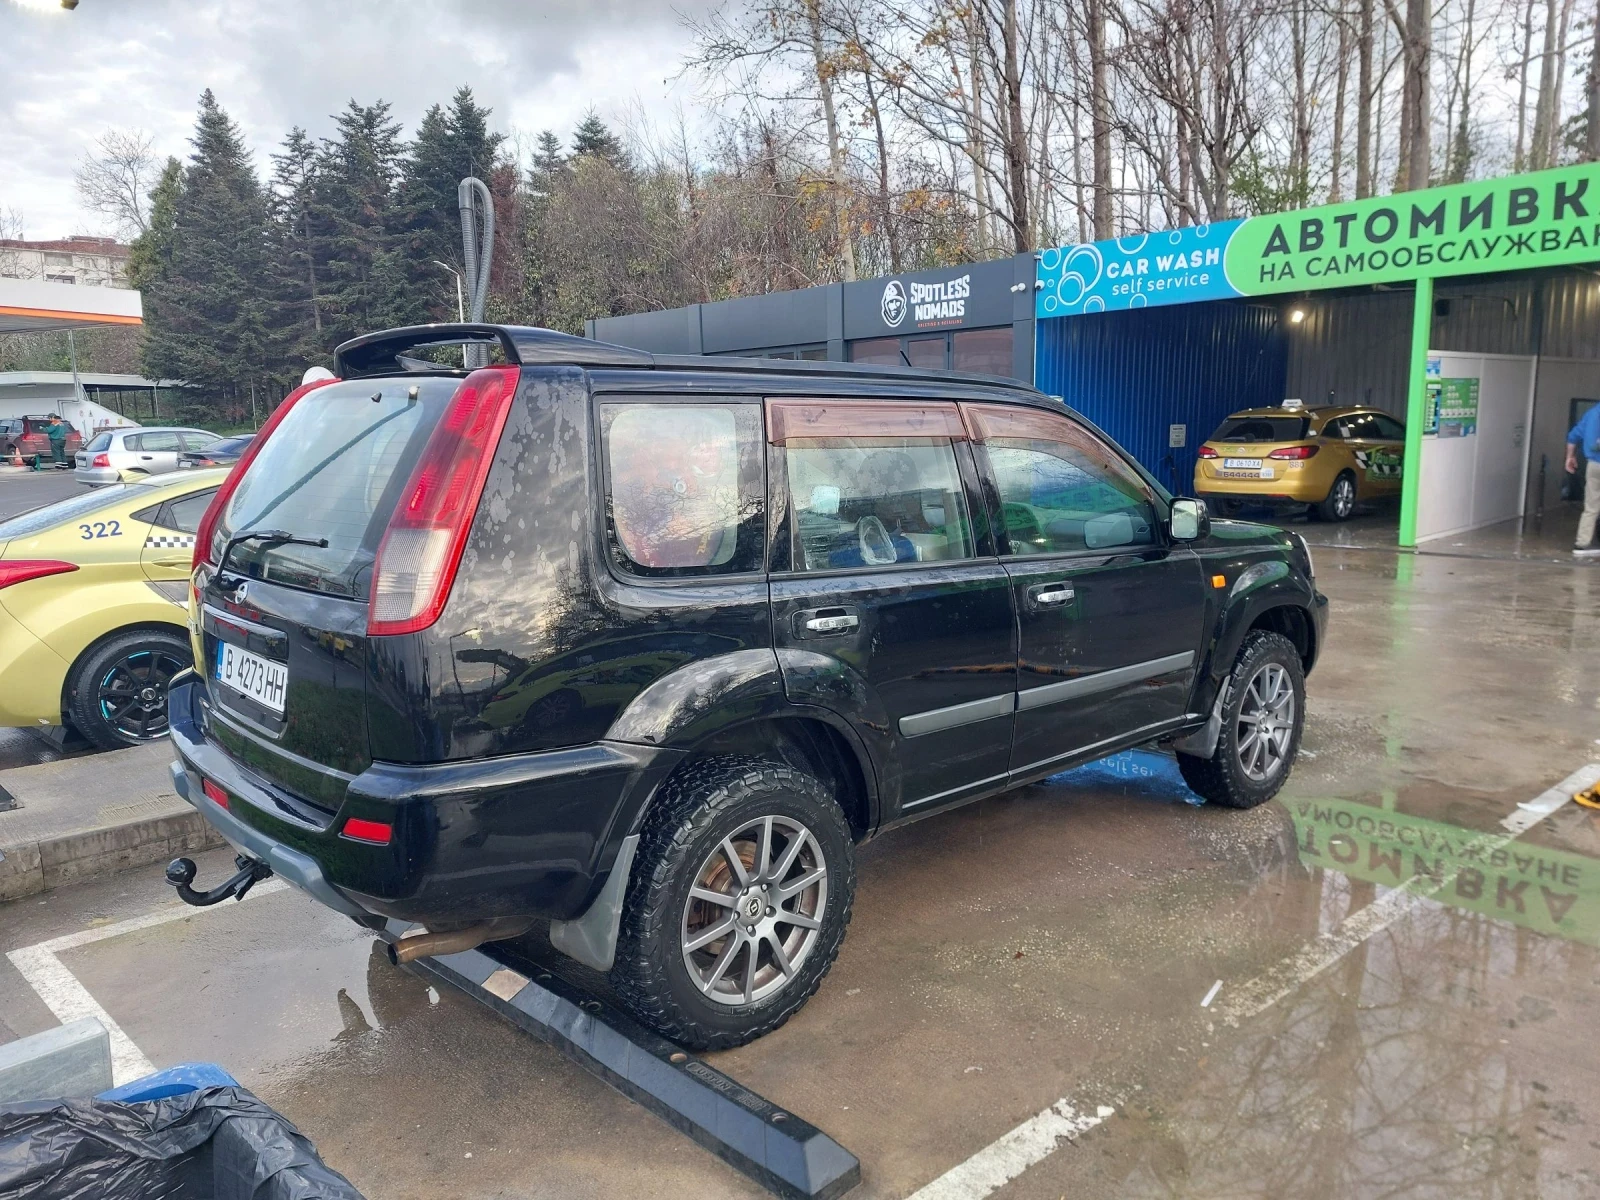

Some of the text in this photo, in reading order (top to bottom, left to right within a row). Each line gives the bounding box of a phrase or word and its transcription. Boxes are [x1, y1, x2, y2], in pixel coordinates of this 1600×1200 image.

[1261, 178, 1600, 259] АВТОМИВК
[1106, 247, 1220, 280] CAR WASH
[1259, 259, 1296, 284] НА
[910, 274, 971, 304] SPOTLESS
[1112, 272, 1210, 297] self service
[914, 299, 965, 321] NOMADS
[79, 520, 122, 540] 322
[225, 648, 234, 680] B
